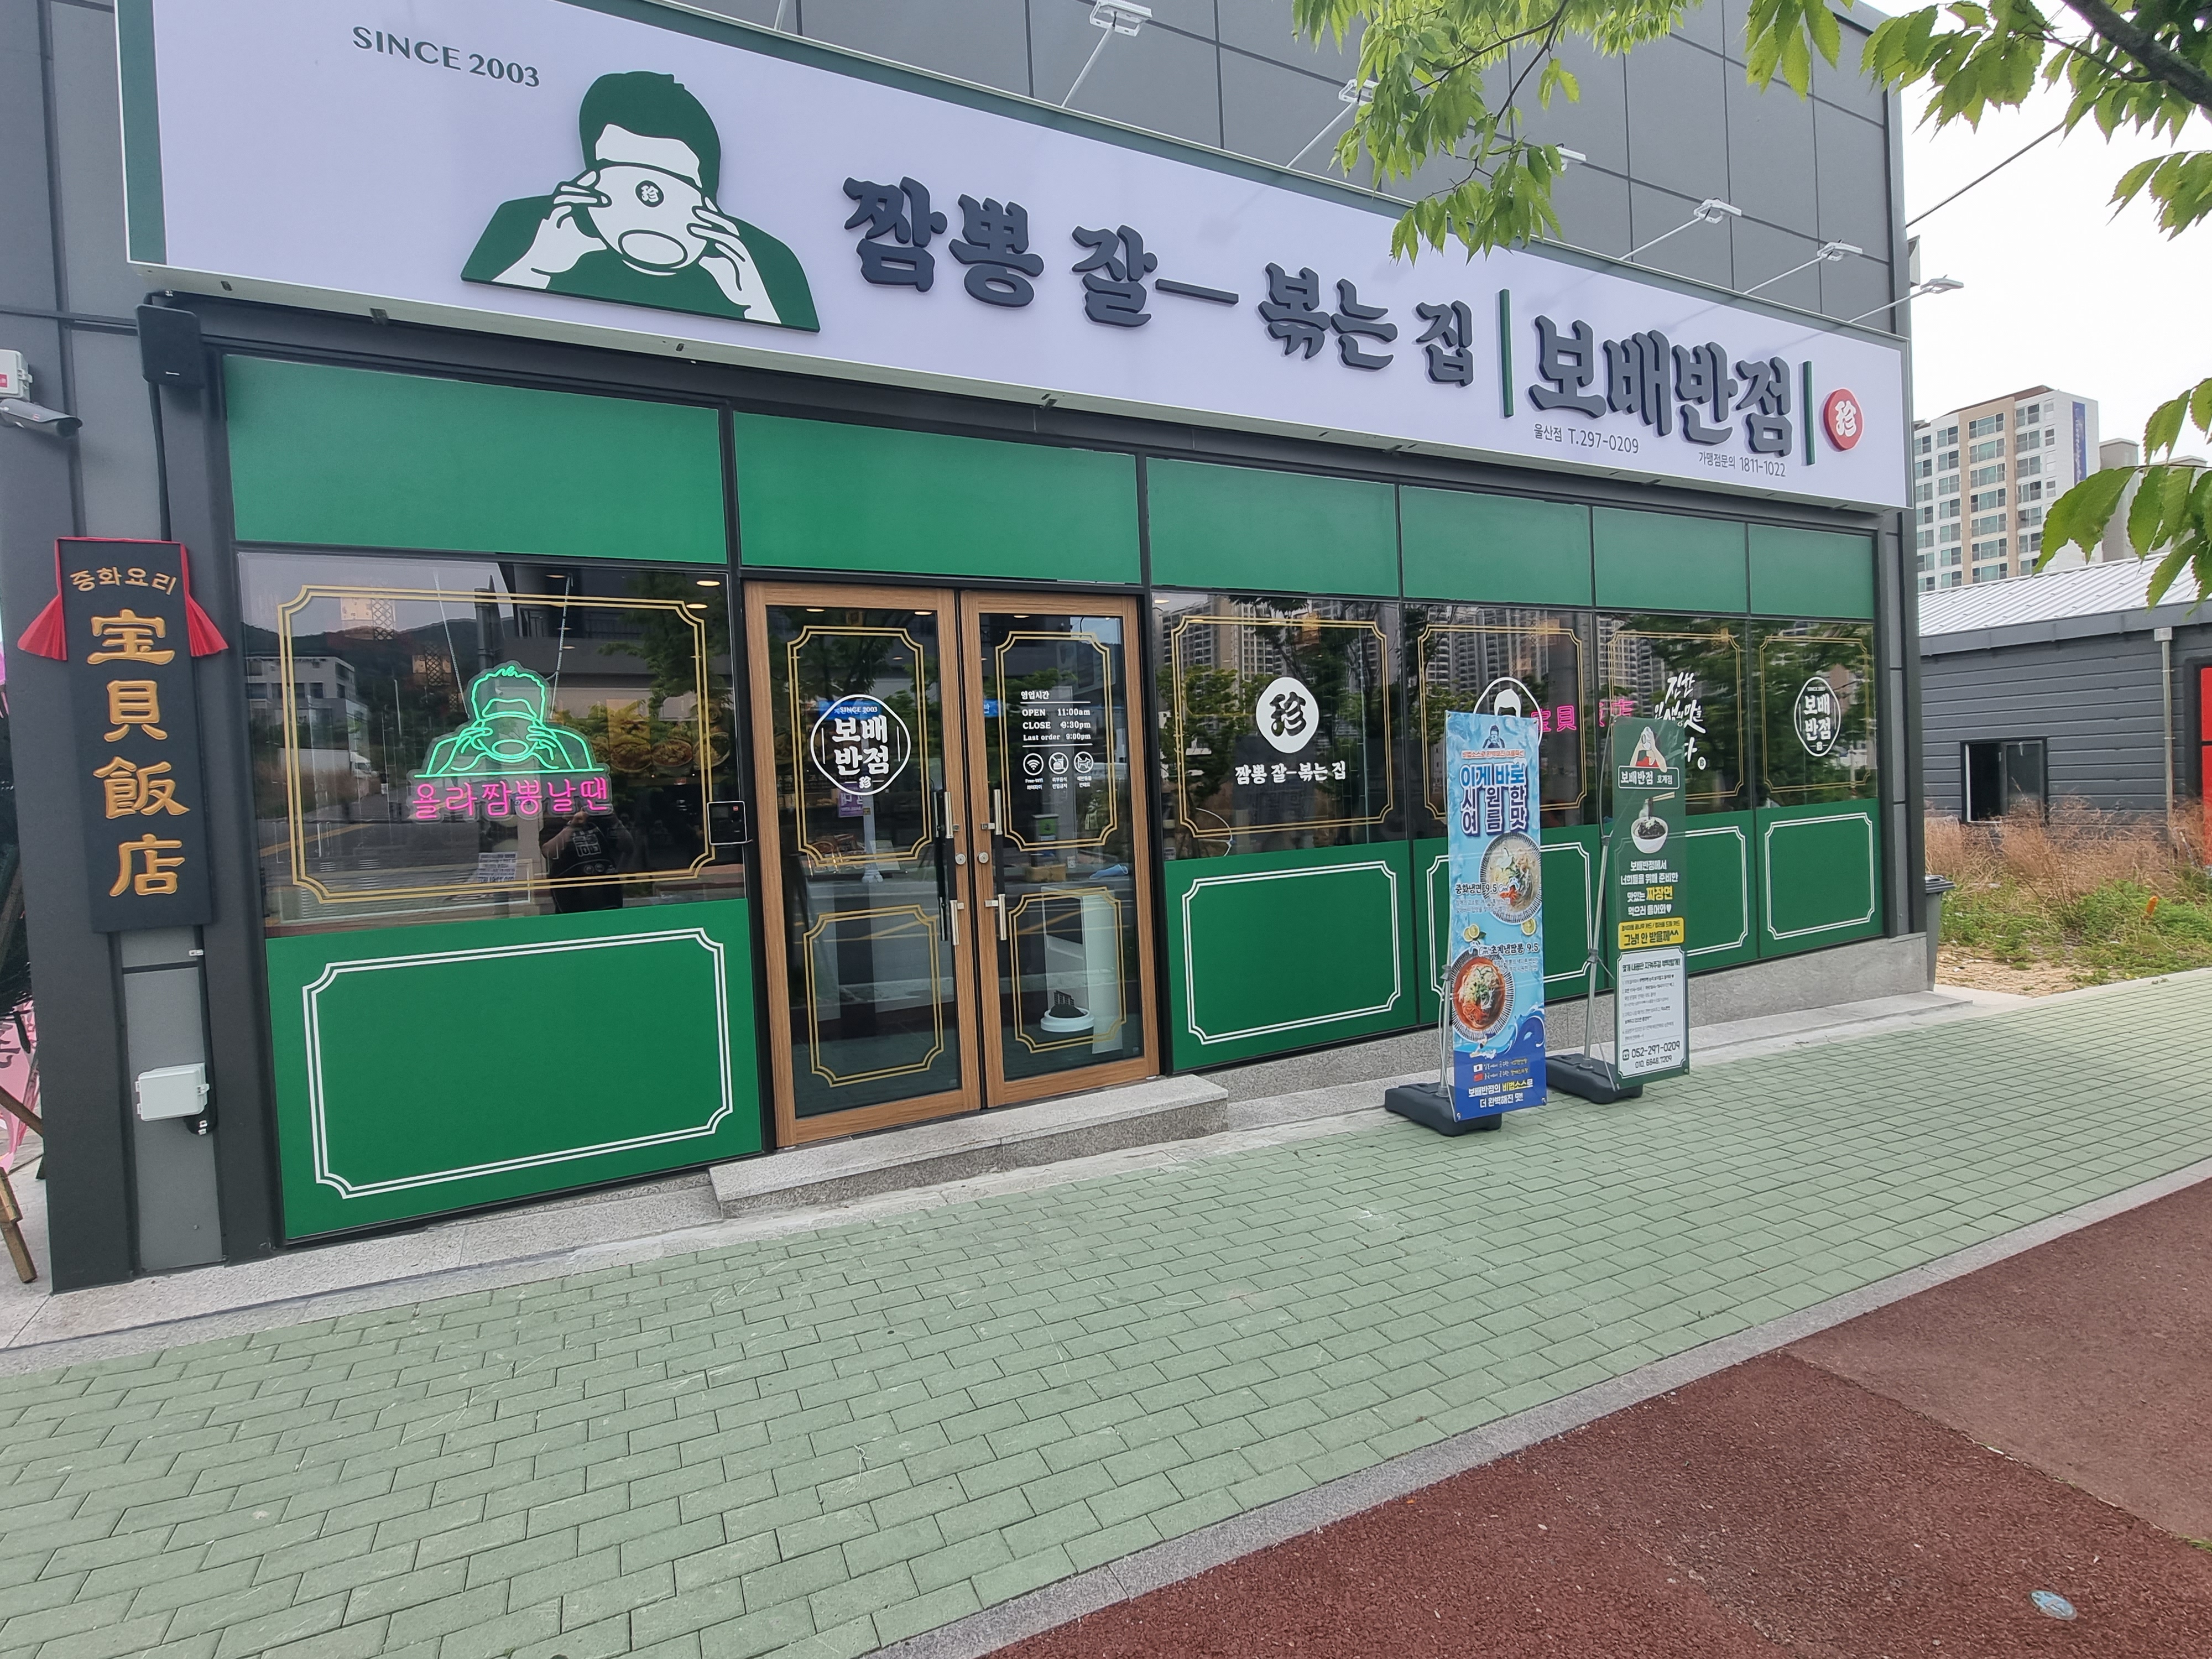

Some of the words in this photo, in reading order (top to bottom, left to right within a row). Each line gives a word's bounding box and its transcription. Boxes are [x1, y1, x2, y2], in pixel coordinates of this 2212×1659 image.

[352, 26, 462, 70] SINCE
[468, 53, 540, 87] 2003
[842, 176, 1045, 308] 짬뽕
[1258, 262, 1399, 372] 볶는
[1415, 300, 1474, 388] 집
[1528, 315, 1792, 457] 보배반점
[1533, 422, 1562, 442] 울산점
[1568, 428, 1639, 454] T.297-0209
[1699, 451, 1735, 469] 가맹점문의
[1739, 457, 1787, 477] 1811-1022
[70, 566, 177, 596] 중화요리
[1021, 691, 1050, 700] 영업시간
[1804, 693, 1830, 715] 보배
[832, 714, 888, 743] 보배
[1804, 717, 1831, 741] 반점
[834, 745, 889, 776] 반점
[1235, 764, 1267, 785] 짬뽕
[1332, 760, 1346, 780] 집
[1460, 765, 1491, 787] 이게
[1495, 763, 1525, 785] 바로
[1620, 770, 1653, 785] 보배반점
[1455, 884, 1482, 894] 중화냉면
[1485, 884, 1497, 893] 9.5
[1646, 885, 1673, 901] 짜장면
[1527, 943, 1538, 952] 9.5
[1631, 1040, 1681, 1058] 052-297-0209
[1502, 1079, 1533, 1091] 비법소스로
[1480, 1099, 1486, 1108] 더
